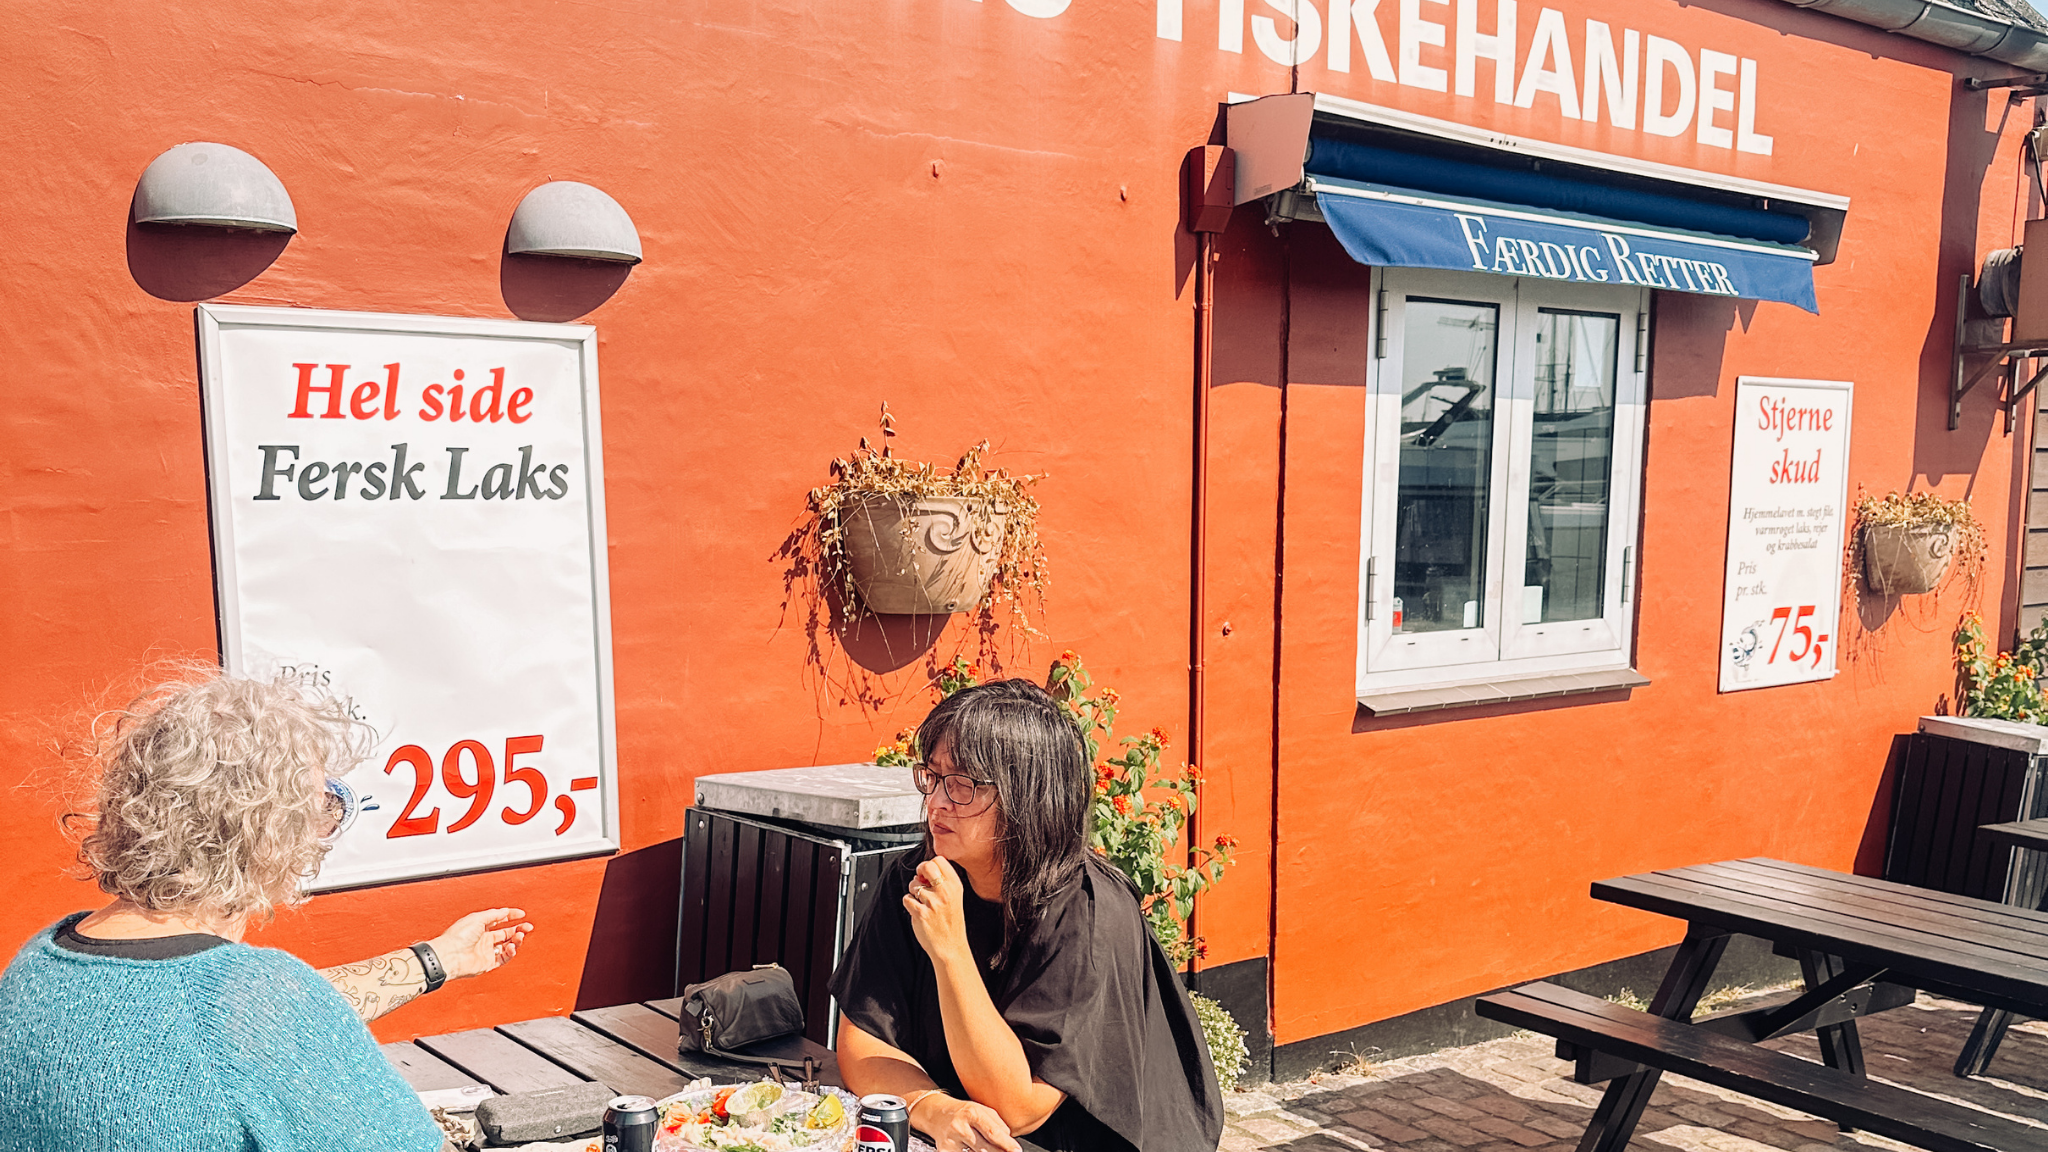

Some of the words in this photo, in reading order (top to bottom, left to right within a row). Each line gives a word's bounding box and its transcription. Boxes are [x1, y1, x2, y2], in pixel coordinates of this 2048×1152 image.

[1453, 213, 1609, 283] FÆRDIG
[1600, 232, 1740, 296] RETTER
[286, 361, 402, 422] Hel
[418, 366, 534, 425] side
[1757, 395, 1833, 443] Stjerne
[252, 442, 427, 502] Fersk
[439, 444, 570, 501] Laks
[1769, 447, 1822, 485] skud
[1743, 506, 1796, 523] Hjemmelavet
[1813, 522, 1829, 536] rejer
[1765, 542, 1777, 555] og
[1777, 537, 1819, 551] krabbesalat
[1737, 561, 1758, 575] Pris
[1735, 585, 1749, 602] pr.
[1750, 580, 1768, 596] stk.
[1767, 604, 1829, 670] 75,-
[279, 664, 332, 688] Pris
[383, 734, 599, 840] 295,-
